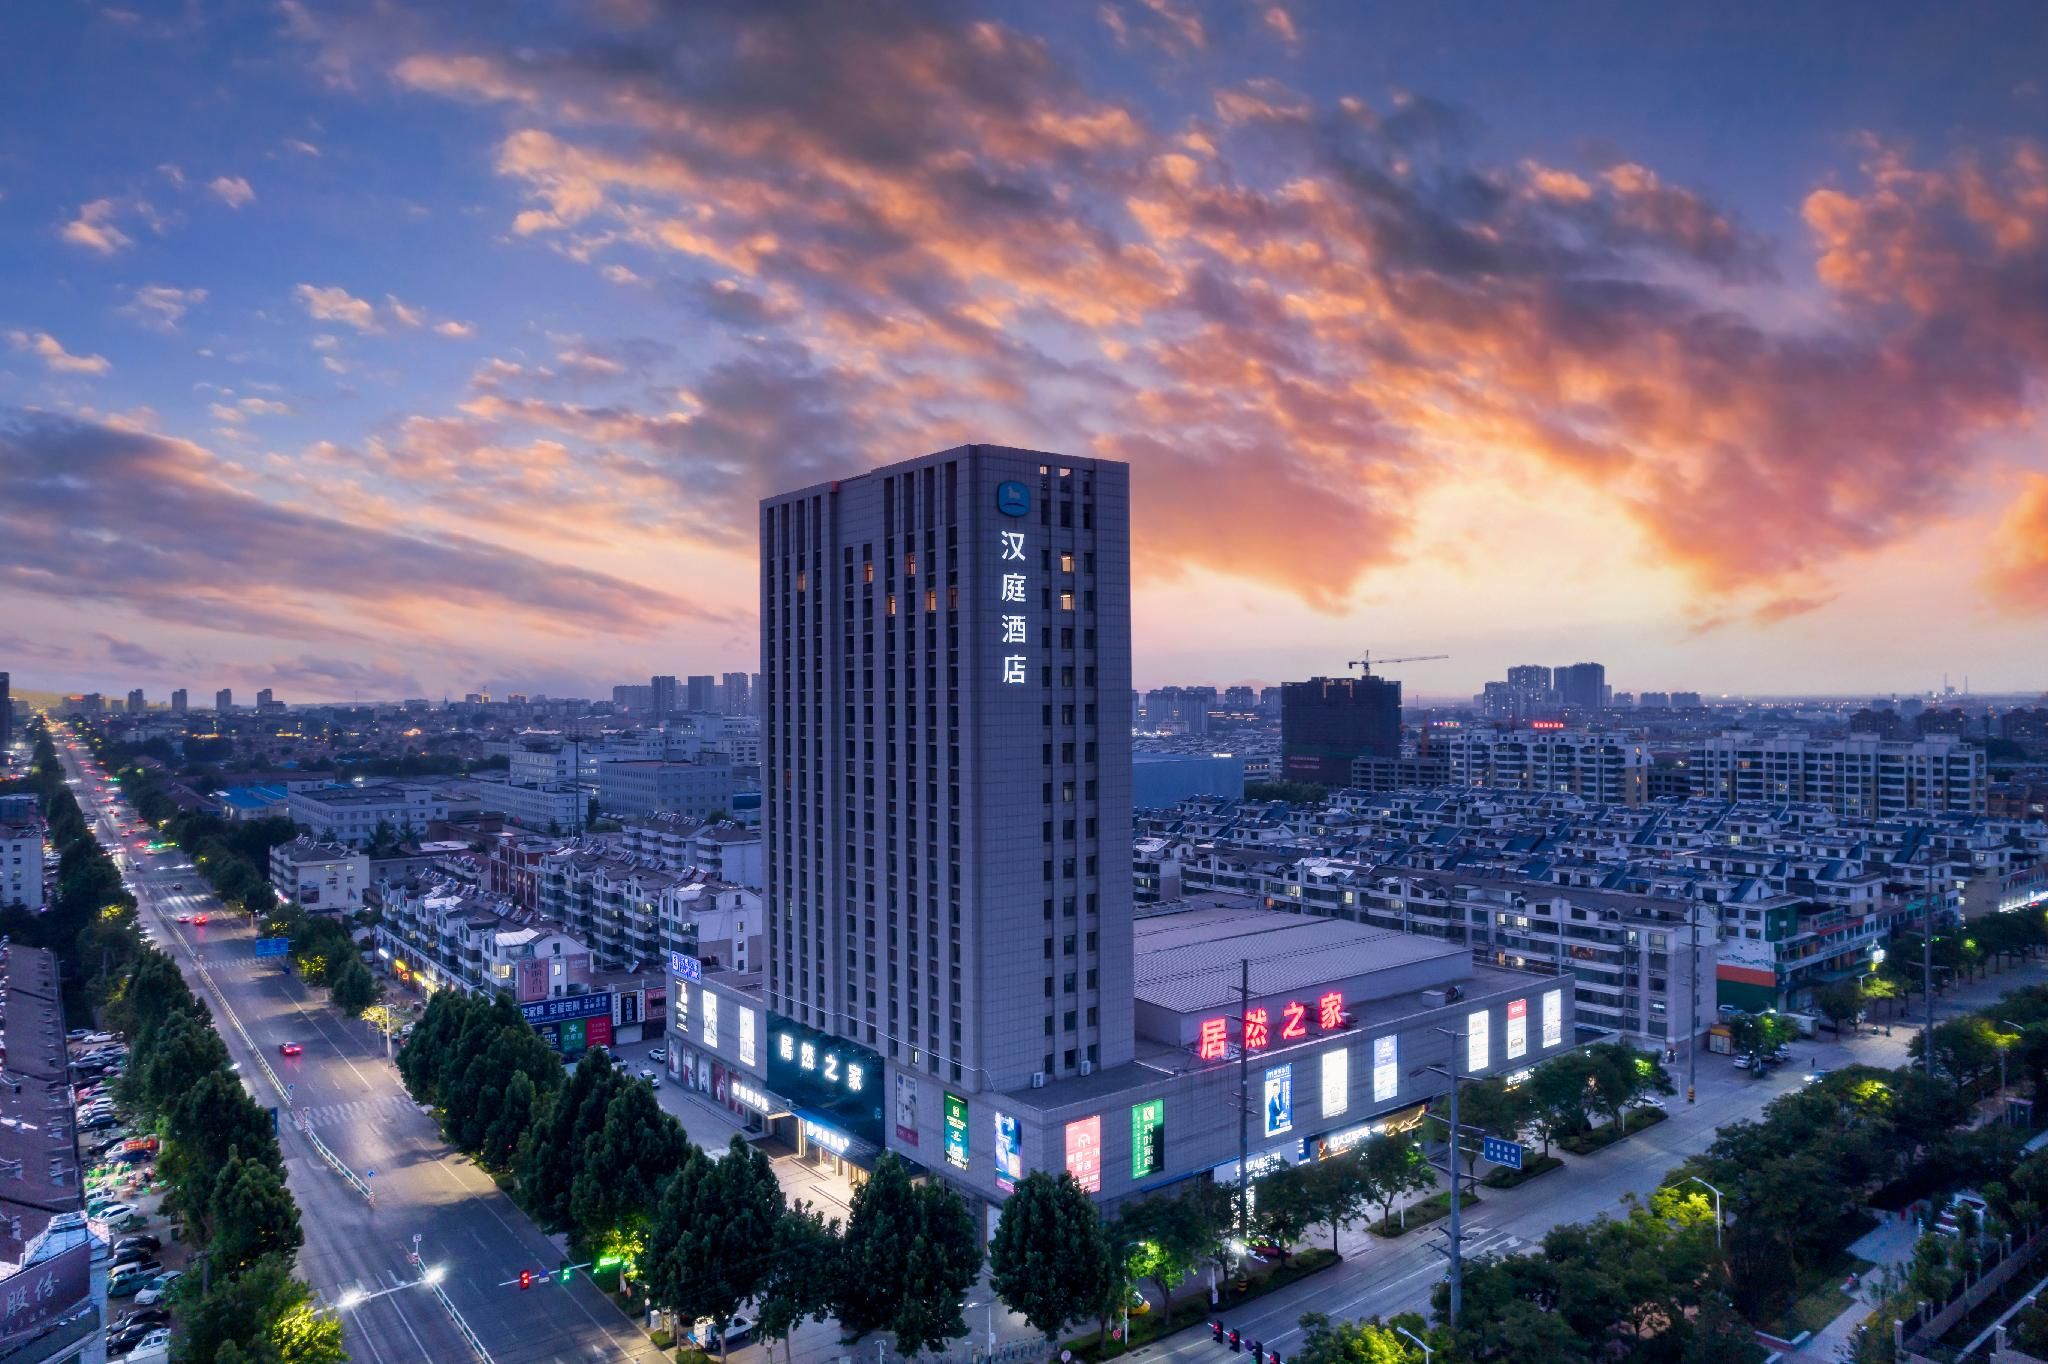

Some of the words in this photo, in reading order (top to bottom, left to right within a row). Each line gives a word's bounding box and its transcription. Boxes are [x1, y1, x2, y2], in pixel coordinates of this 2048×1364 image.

[1001, 529, 1027, 684] 汉庭酒店
[549, 1000, 580, 1015] 全屋定制
[1200, 991, 1343, 1060] 居然之家
[780, 1033, 863, 1091] 居然之家
